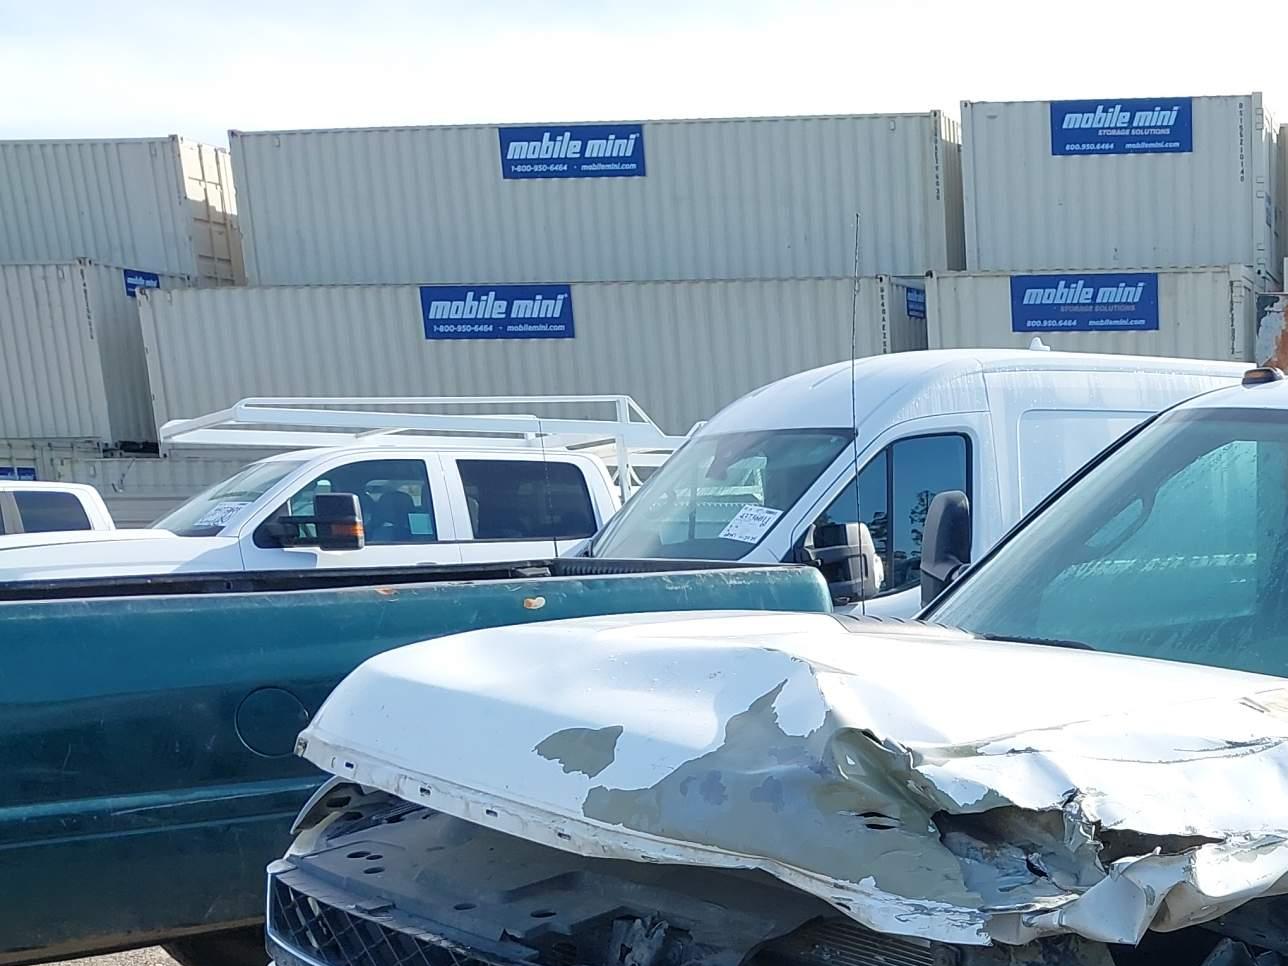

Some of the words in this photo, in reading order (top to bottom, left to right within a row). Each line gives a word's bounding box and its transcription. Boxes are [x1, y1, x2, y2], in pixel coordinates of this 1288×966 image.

[1062, 104, 1130, 129] mobile
[1132, 106, 1178, 127] mini
[507, 131, 582, 159] mobile
[584, 133, 637, 157] mini
[581, 162, 637, 171] mobilemini.com
[428, 291, 508, 319] mobile
[510, 294, 565, 318] mini
[1023, 280, 1094, 305] mobile
[1095, 282, 1144, 303] mini
[507, 323, 566, 332] mobilemini.com
